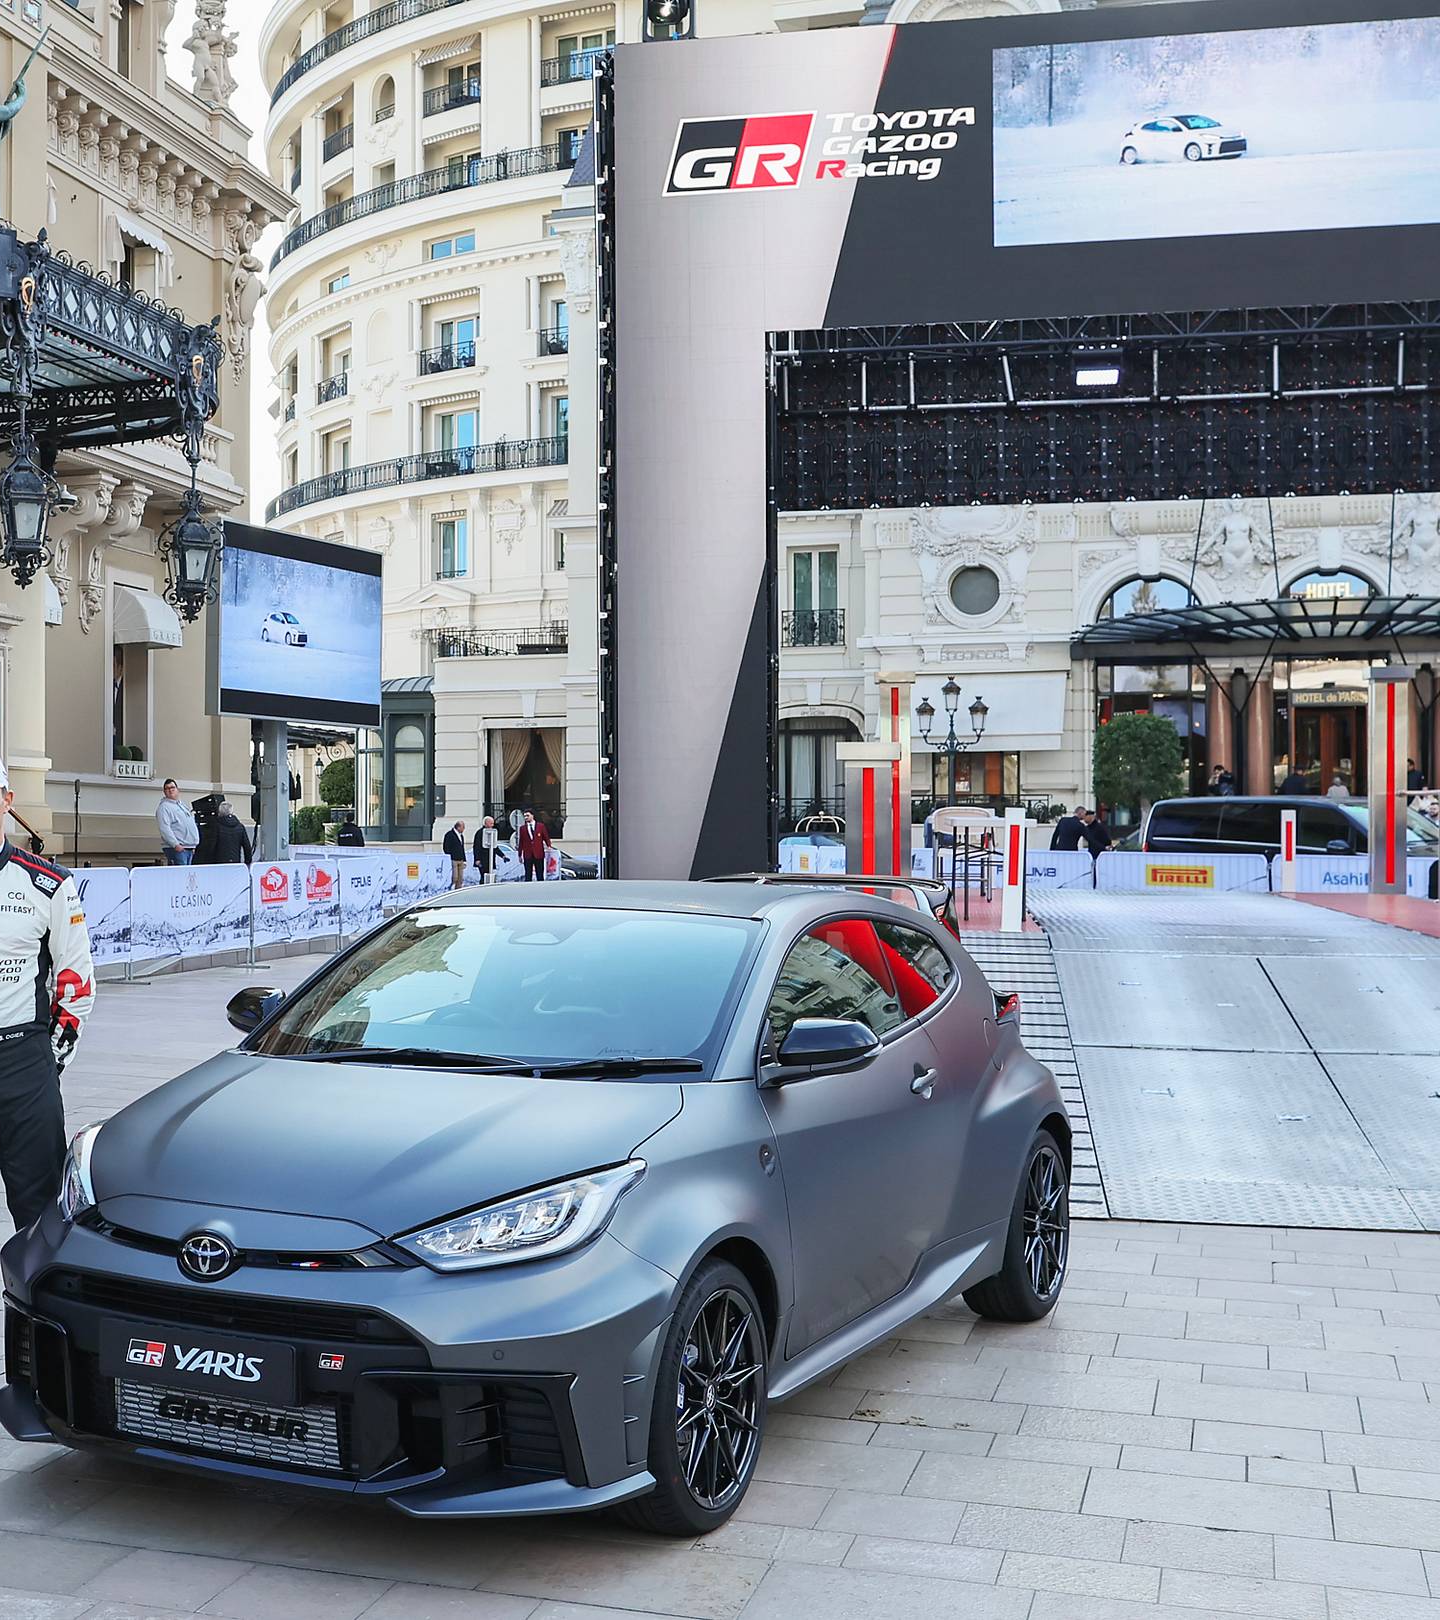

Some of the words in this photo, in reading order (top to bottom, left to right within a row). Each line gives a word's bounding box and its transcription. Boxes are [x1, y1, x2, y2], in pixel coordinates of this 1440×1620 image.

[825, 106, 975, 134] TOYOTA
[821, 131, 959, 157] GAZOO
[672, 143, 802, 189] GR
[815, 155, 942, 182] Racing
[1295, 691, 1325, 703] HOTEL
[35, 876, 58, 889] OMP
[1151, 868, 1209, 885] PIRELLI
[180, 893, 212, 908] CASINO
[5, 1031, 25, 1040] OGIER
[128, 1348, 163, 1366] GR
[320, 1358, 343, 1369] GR
